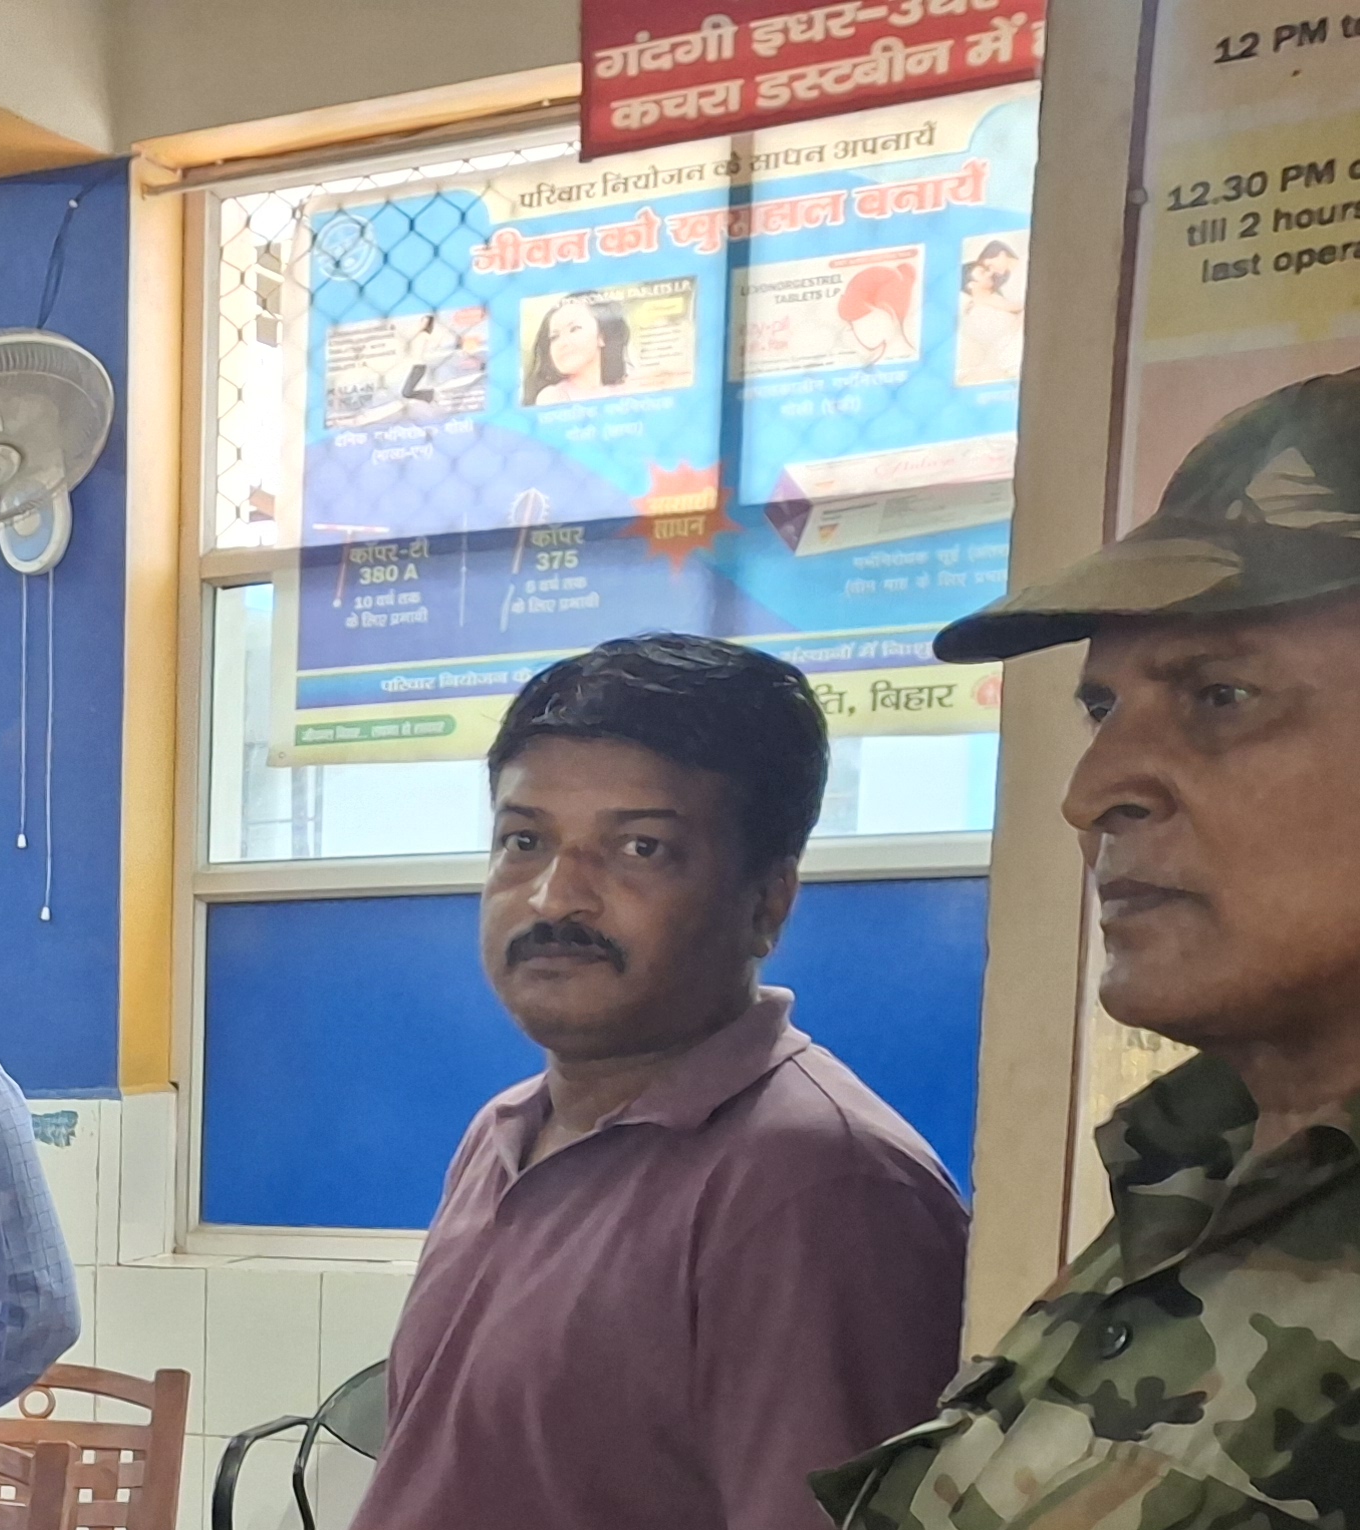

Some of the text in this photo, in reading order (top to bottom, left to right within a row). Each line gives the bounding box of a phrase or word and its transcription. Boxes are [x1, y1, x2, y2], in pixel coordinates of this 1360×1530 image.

[594, 13, 739, 80] गंदगी
[1213, 32, 1260, 64] 12
[1273, 16, 1328, 53] PM
[610, 78, 744, 132] कचरा
[755, 36, 955, 111] डस्टबीन
[966, 12, 1028, 66] में
[518, 178, 597, 211] परिवार
[601, 164, 706, 199] नियोजन
[748, 142, 827, 173] साधन
[833, 121, 939, 161] अपनायें
[1166, 171, 1269, 211] 12.30
[1280, 159, 1336, 192] PM
[469, 227, 592, 275] जीवन
[595, 205, 663, 255] को
[1187, 216, 1227, 247] till
[1239, 211, 1262, 238] 2
[1202, 253, 1261, 283] last
[774, 289, 830, 304] TABLETS
[349, 537, 430, 564] कॉपर-टी
[530, 524, 586, 548] कॉपर
[359, 565, 419, 584] 380 A
[536, 550, 579, 571] 375
[354, 595, 373, 610] 10
[815, 680, 958, 717] ति, बिहार
